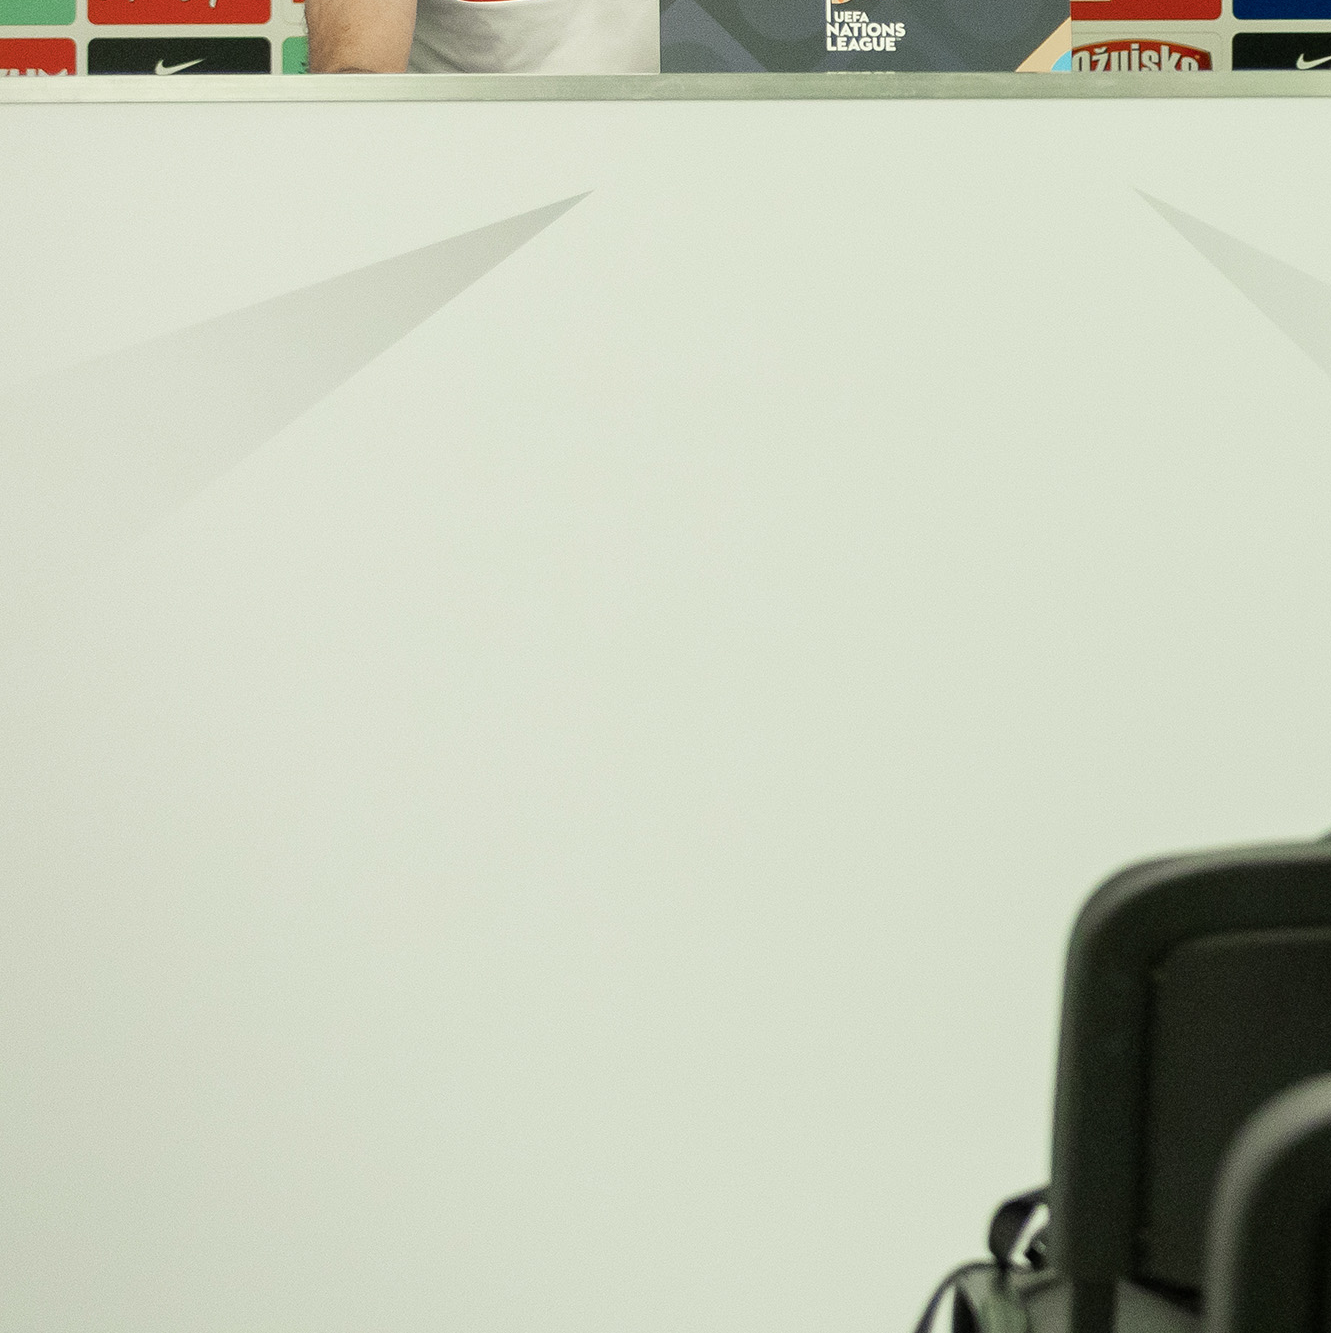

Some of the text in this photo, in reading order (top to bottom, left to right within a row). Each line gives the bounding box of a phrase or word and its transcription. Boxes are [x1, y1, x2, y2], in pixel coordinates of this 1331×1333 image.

[835, 12, 868, 22] UEFA
[827, 22, 905, 37] NATIONS
[827, 36, 896, 52] LEAGUE
